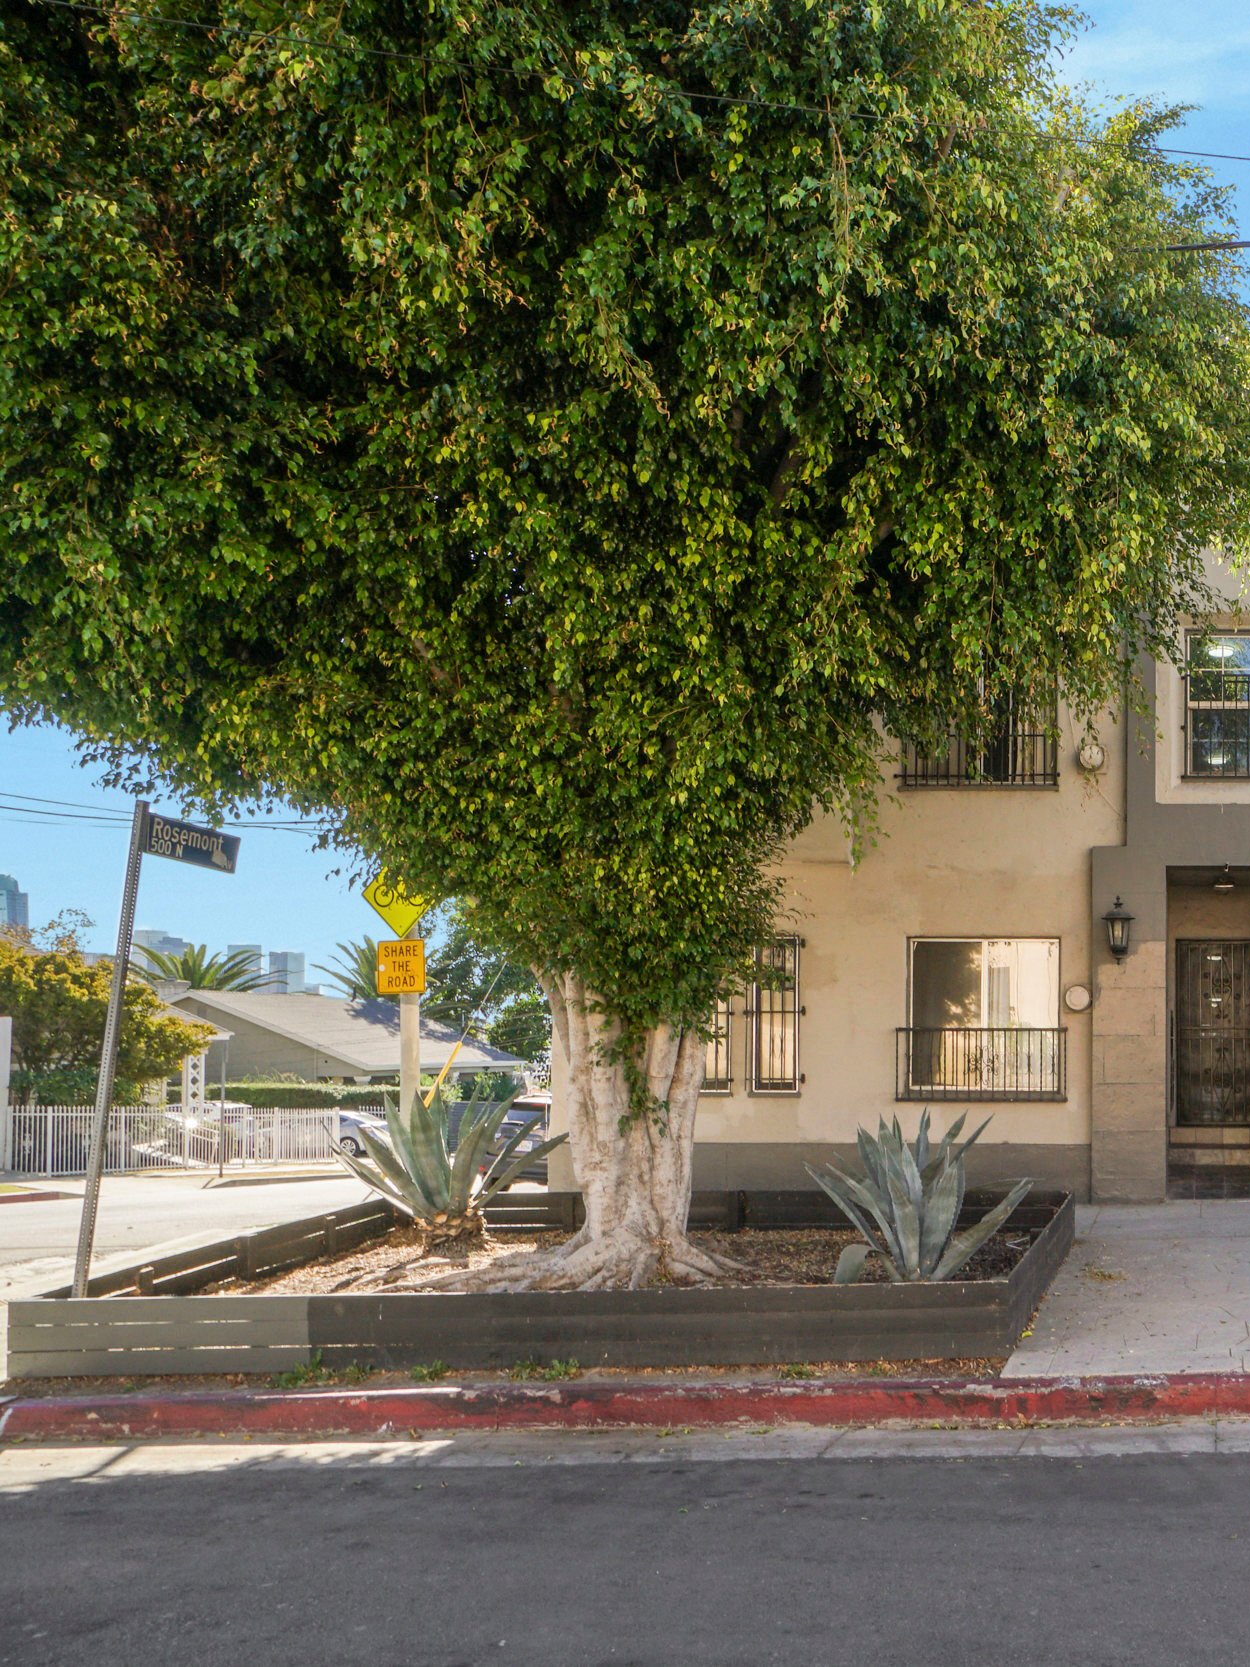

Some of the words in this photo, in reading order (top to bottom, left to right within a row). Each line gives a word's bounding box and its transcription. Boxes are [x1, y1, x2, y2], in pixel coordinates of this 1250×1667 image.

[152, 818, 224, 852] Rosemont
[151, 838, 172, 855] 500
[175, 844, 184, 858] N
[384, 945, 418, 958] SHARE
[392, 961, 411, 973] THE
[387, 976, 416, 988] ROAD
